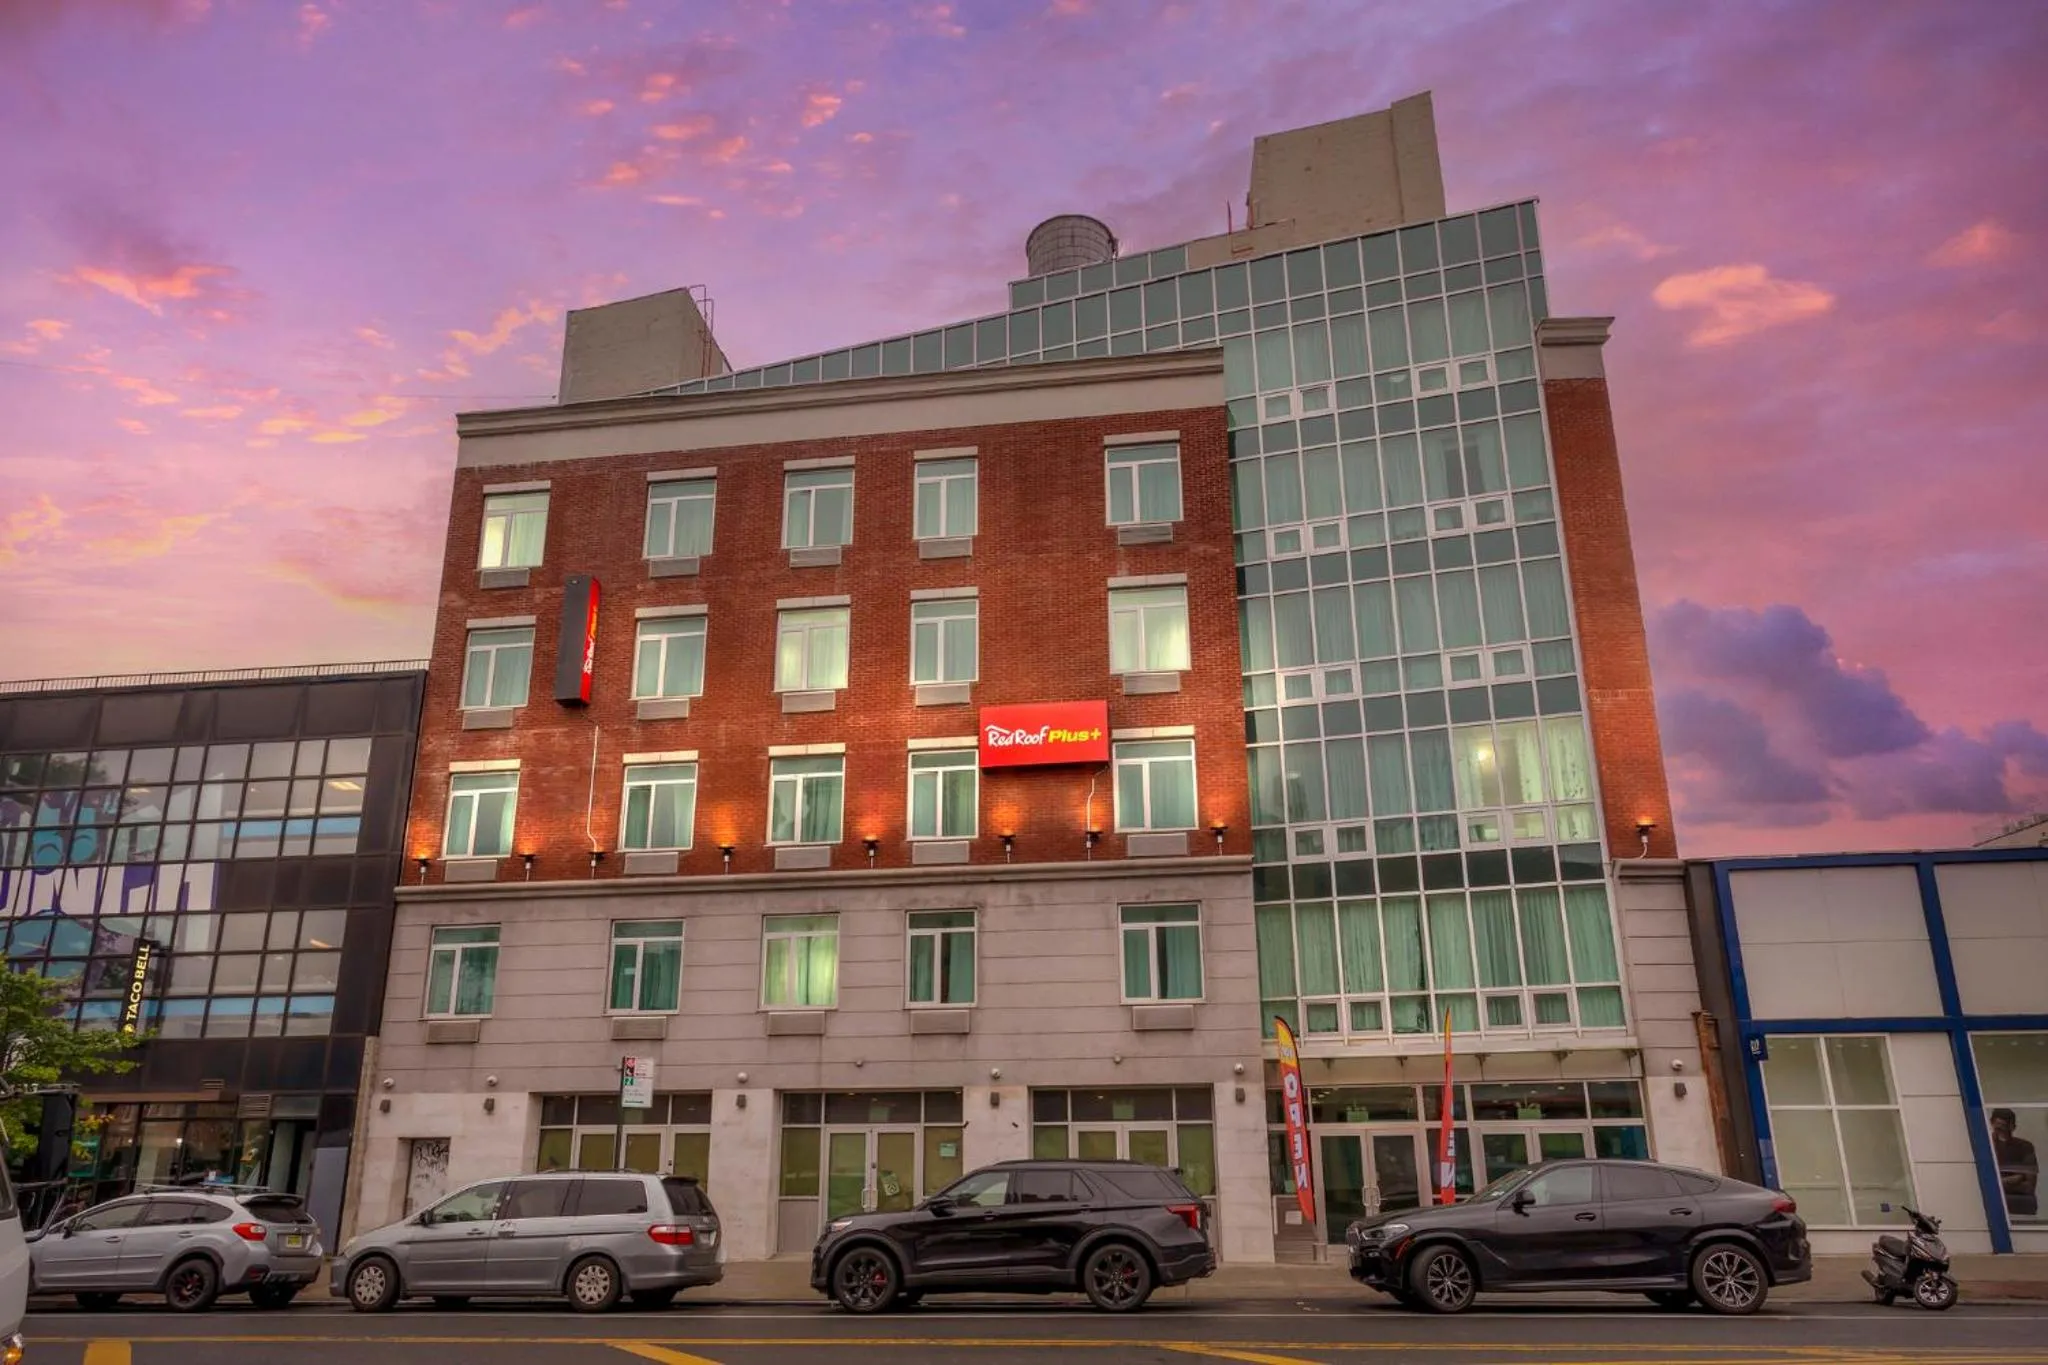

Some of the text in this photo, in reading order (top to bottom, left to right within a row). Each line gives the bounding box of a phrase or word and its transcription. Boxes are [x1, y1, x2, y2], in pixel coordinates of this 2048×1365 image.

[986, 725, 1101, 747] Red Roof Plus+
[126, 944, 151, 1021] TACO BELL
